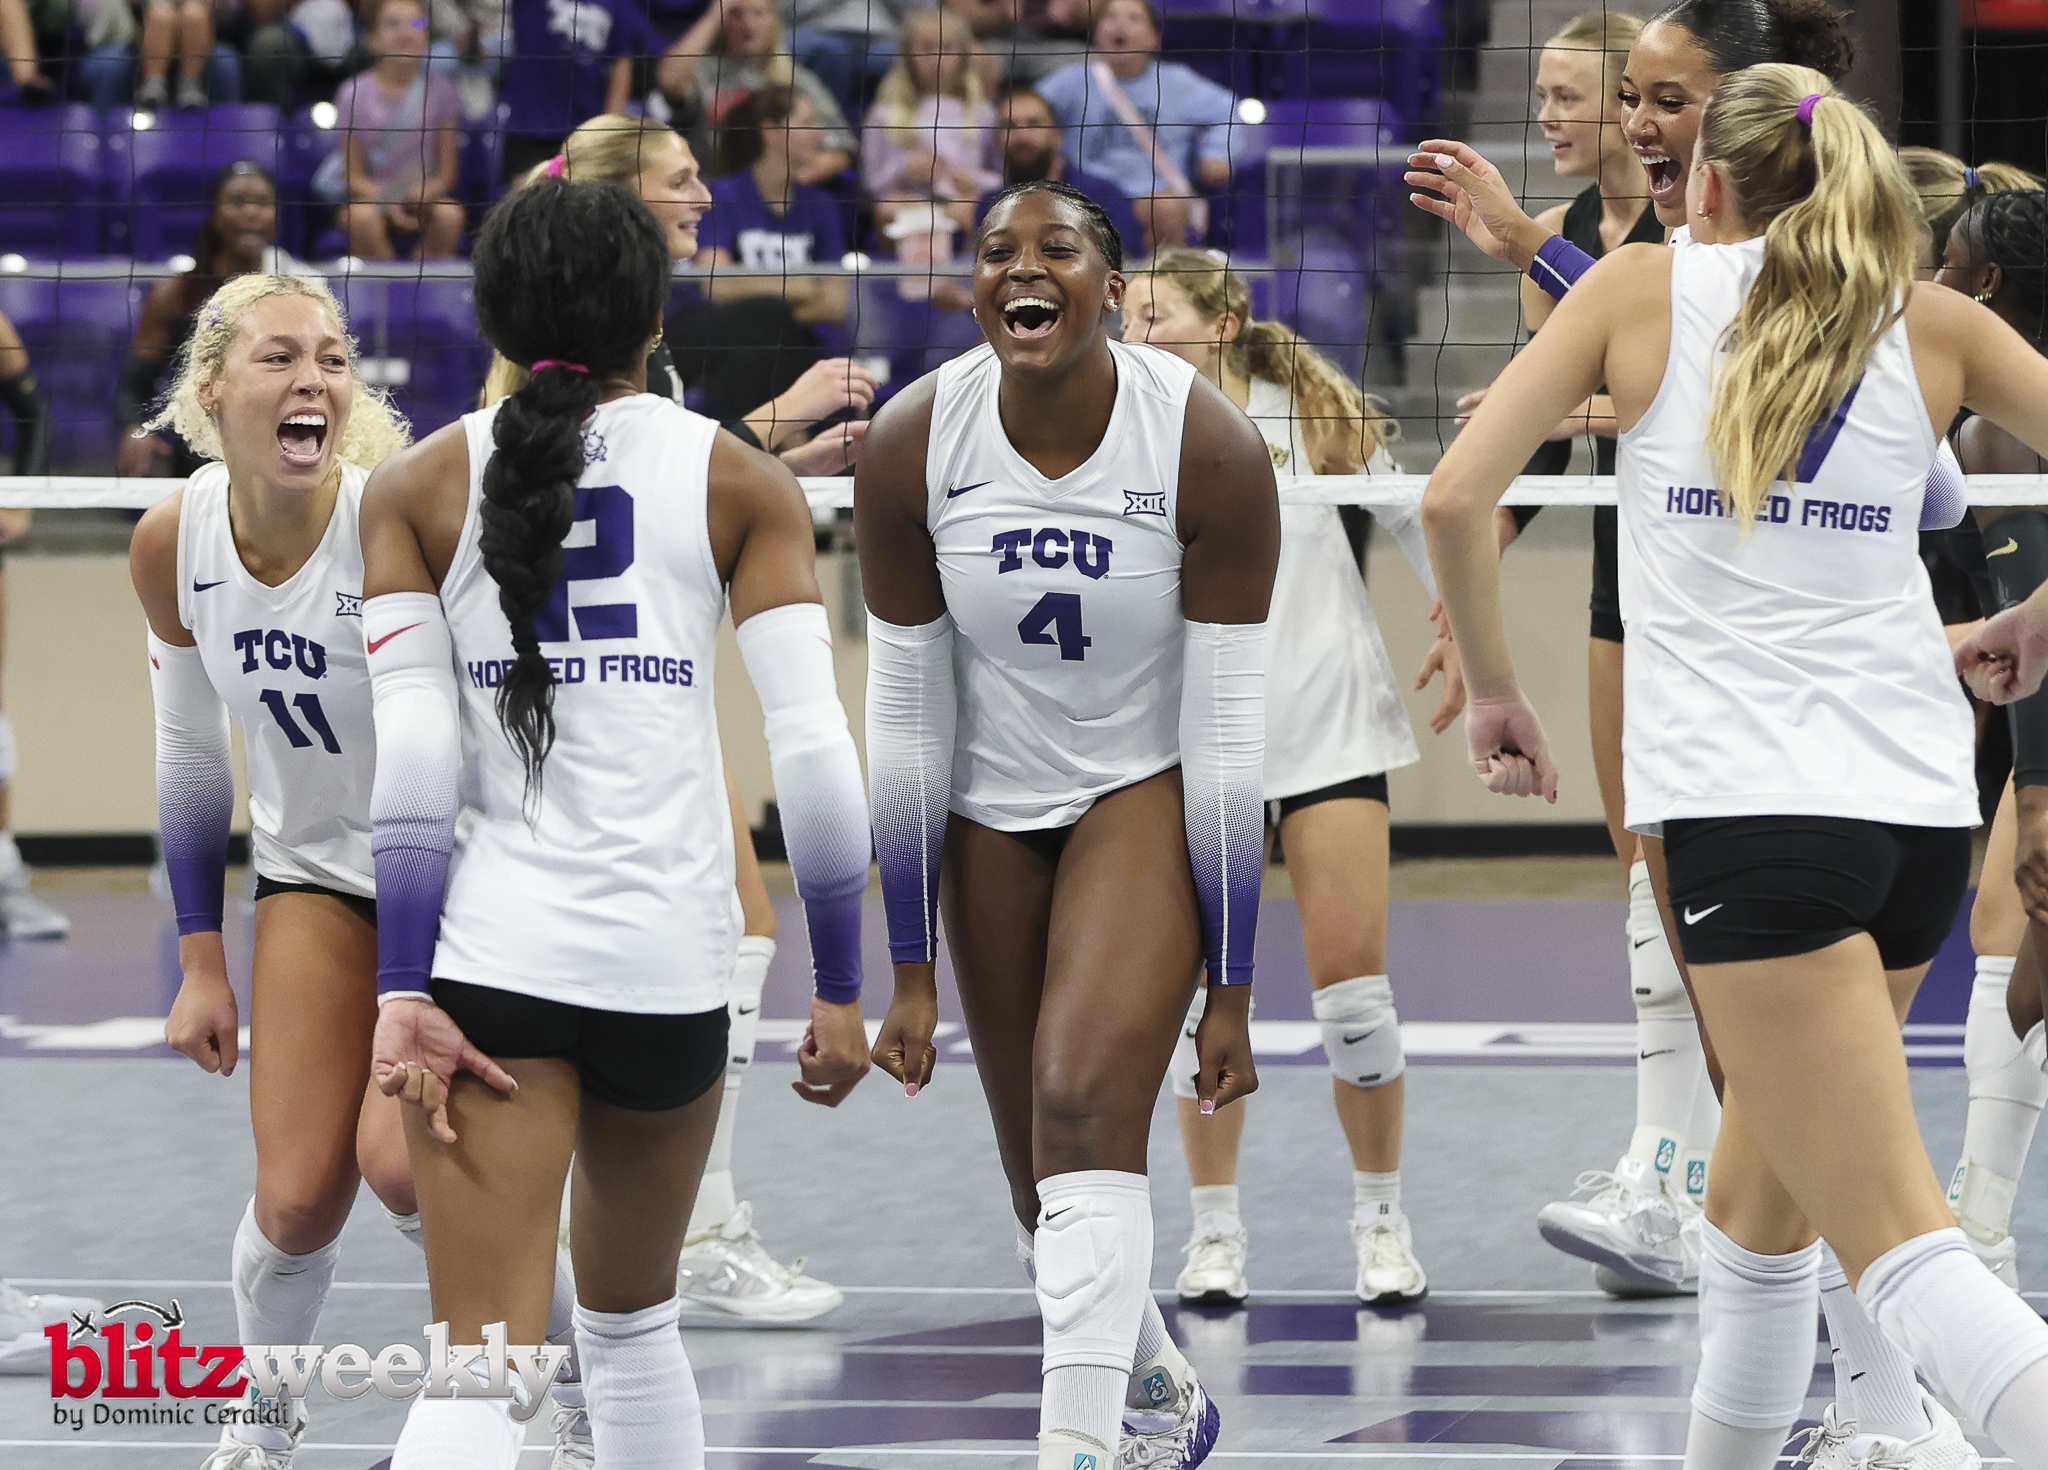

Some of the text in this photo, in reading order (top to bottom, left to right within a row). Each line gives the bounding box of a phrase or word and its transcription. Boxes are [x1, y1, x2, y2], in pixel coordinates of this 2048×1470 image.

[1666, 486, 1893, 533] HORD FROGS
[991, 527, 1114, 580] TCU
[1017, 591, 1092, 662] 4
[233, 629, 328, 681] TCU
[468, 655, 694, 689] HOED FROGS
[259, 688, 343, 755] 11
